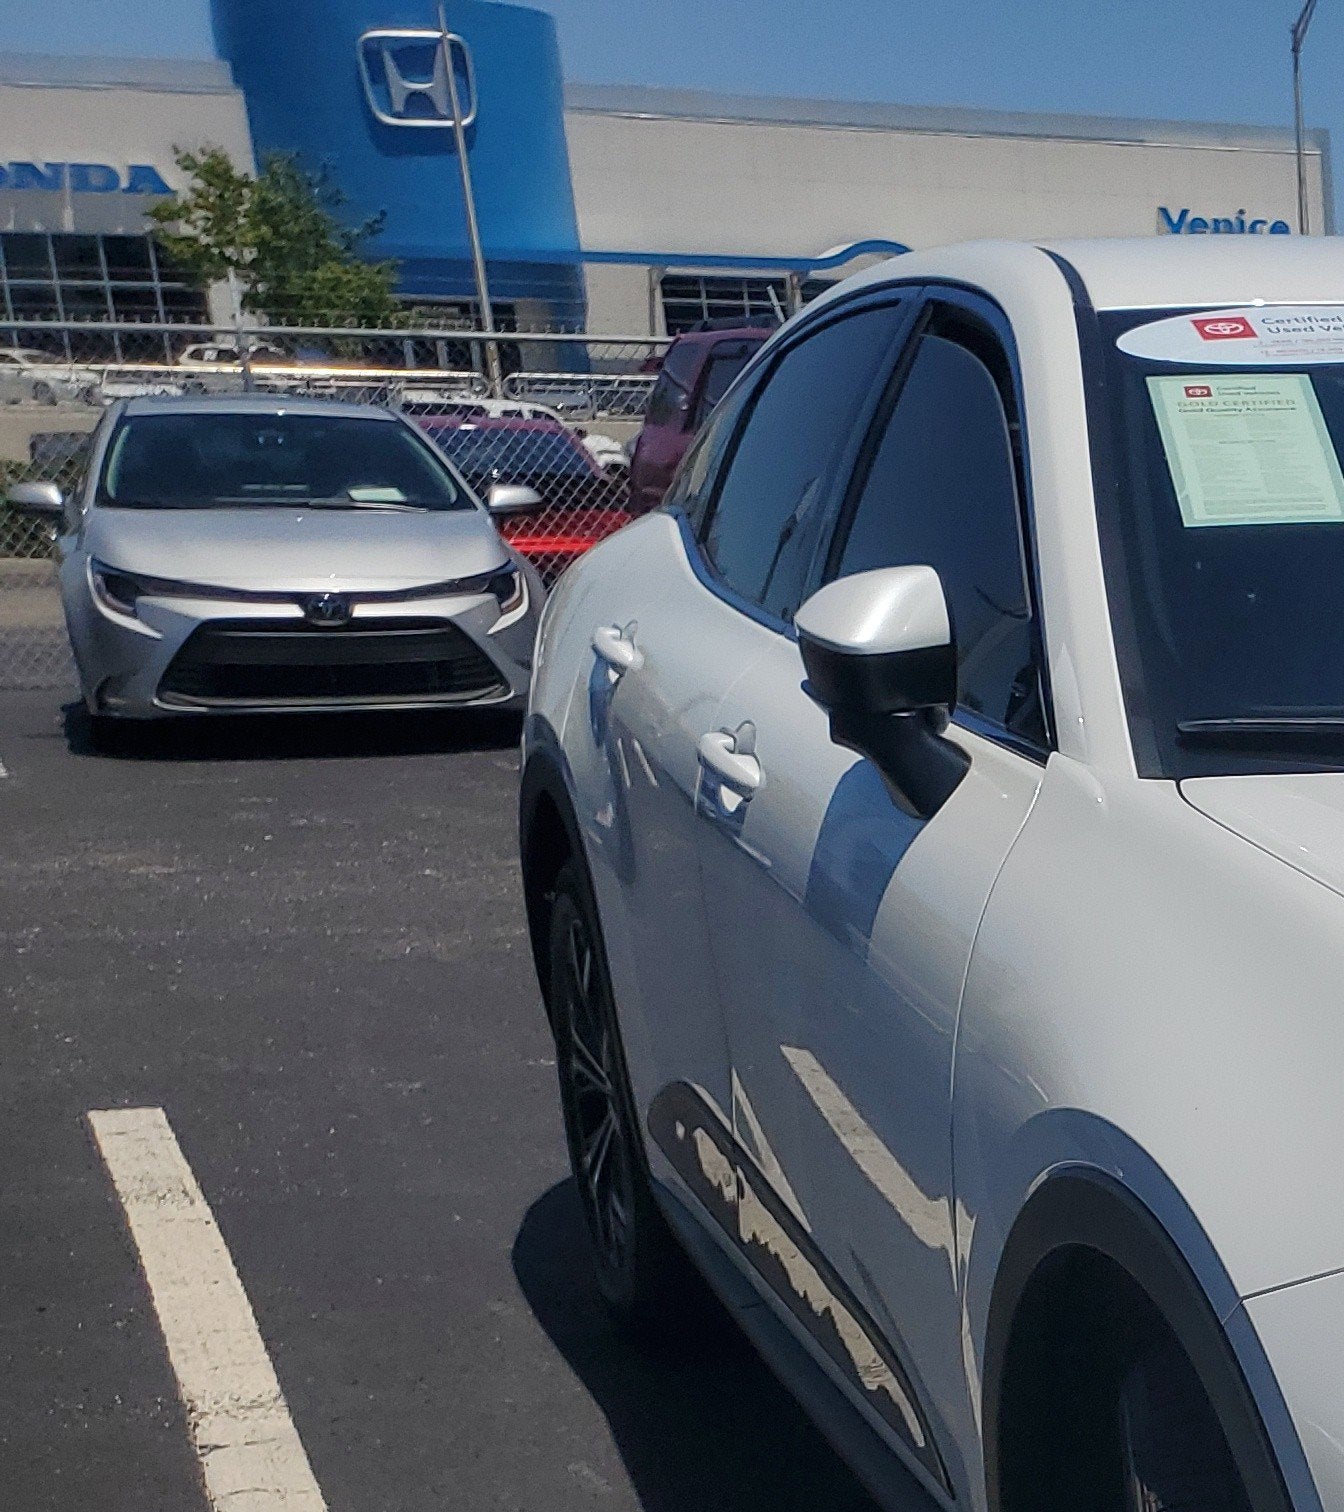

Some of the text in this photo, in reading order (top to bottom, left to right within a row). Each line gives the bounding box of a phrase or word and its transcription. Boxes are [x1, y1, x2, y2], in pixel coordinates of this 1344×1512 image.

[0, 161, 177, 194] NDA
[1261, 315, 1343, 325] Certified
[1267, 326, 1315, 334] Used
